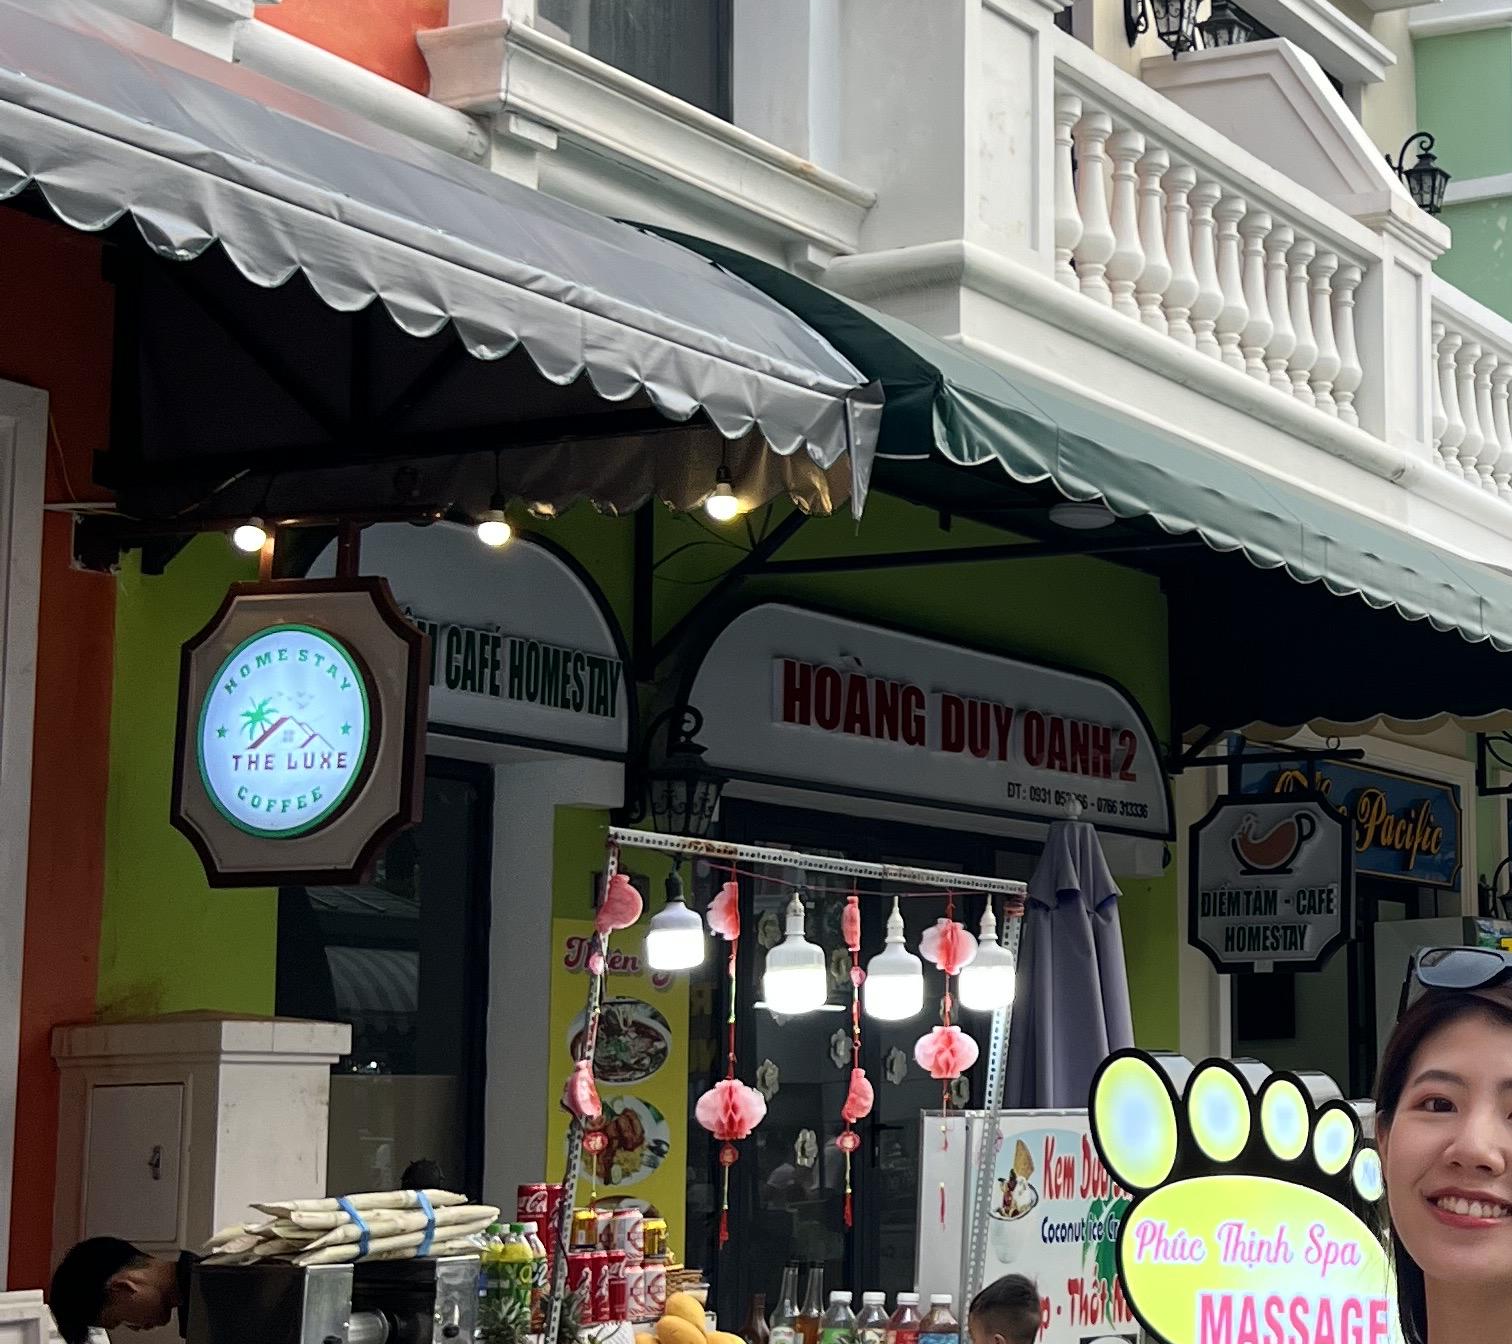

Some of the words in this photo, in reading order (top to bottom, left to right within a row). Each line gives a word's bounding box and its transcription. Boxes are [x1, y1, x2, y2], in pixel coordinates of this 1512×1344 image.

[445, 625, 502, 697] CAFÉ
[508, 638, 623, 718] HOMESTAY
[782, 656, 926, 748] HOÀNG
[940, 693, 1015, 757] DUY
[1022, 709, 1114, 780] OANH
[1118, 728, 1137, 782] 2
[232, 753, 275, 772] THE
[287, 751, 348, 771] LUXE
[237, 785, 324, 814] COFFEE
[1355, 786, 1444, 870] Pacific
[1224, 924, 1308, 954] HOMESTAY
[1043, 1135, 1075, 1200] Kem
[1041, 1215, 1085, 1244] Coconut
[1135, 1218, 1206, 1263] Phúc
[1304, 1223, 1363, 1279] Spa
